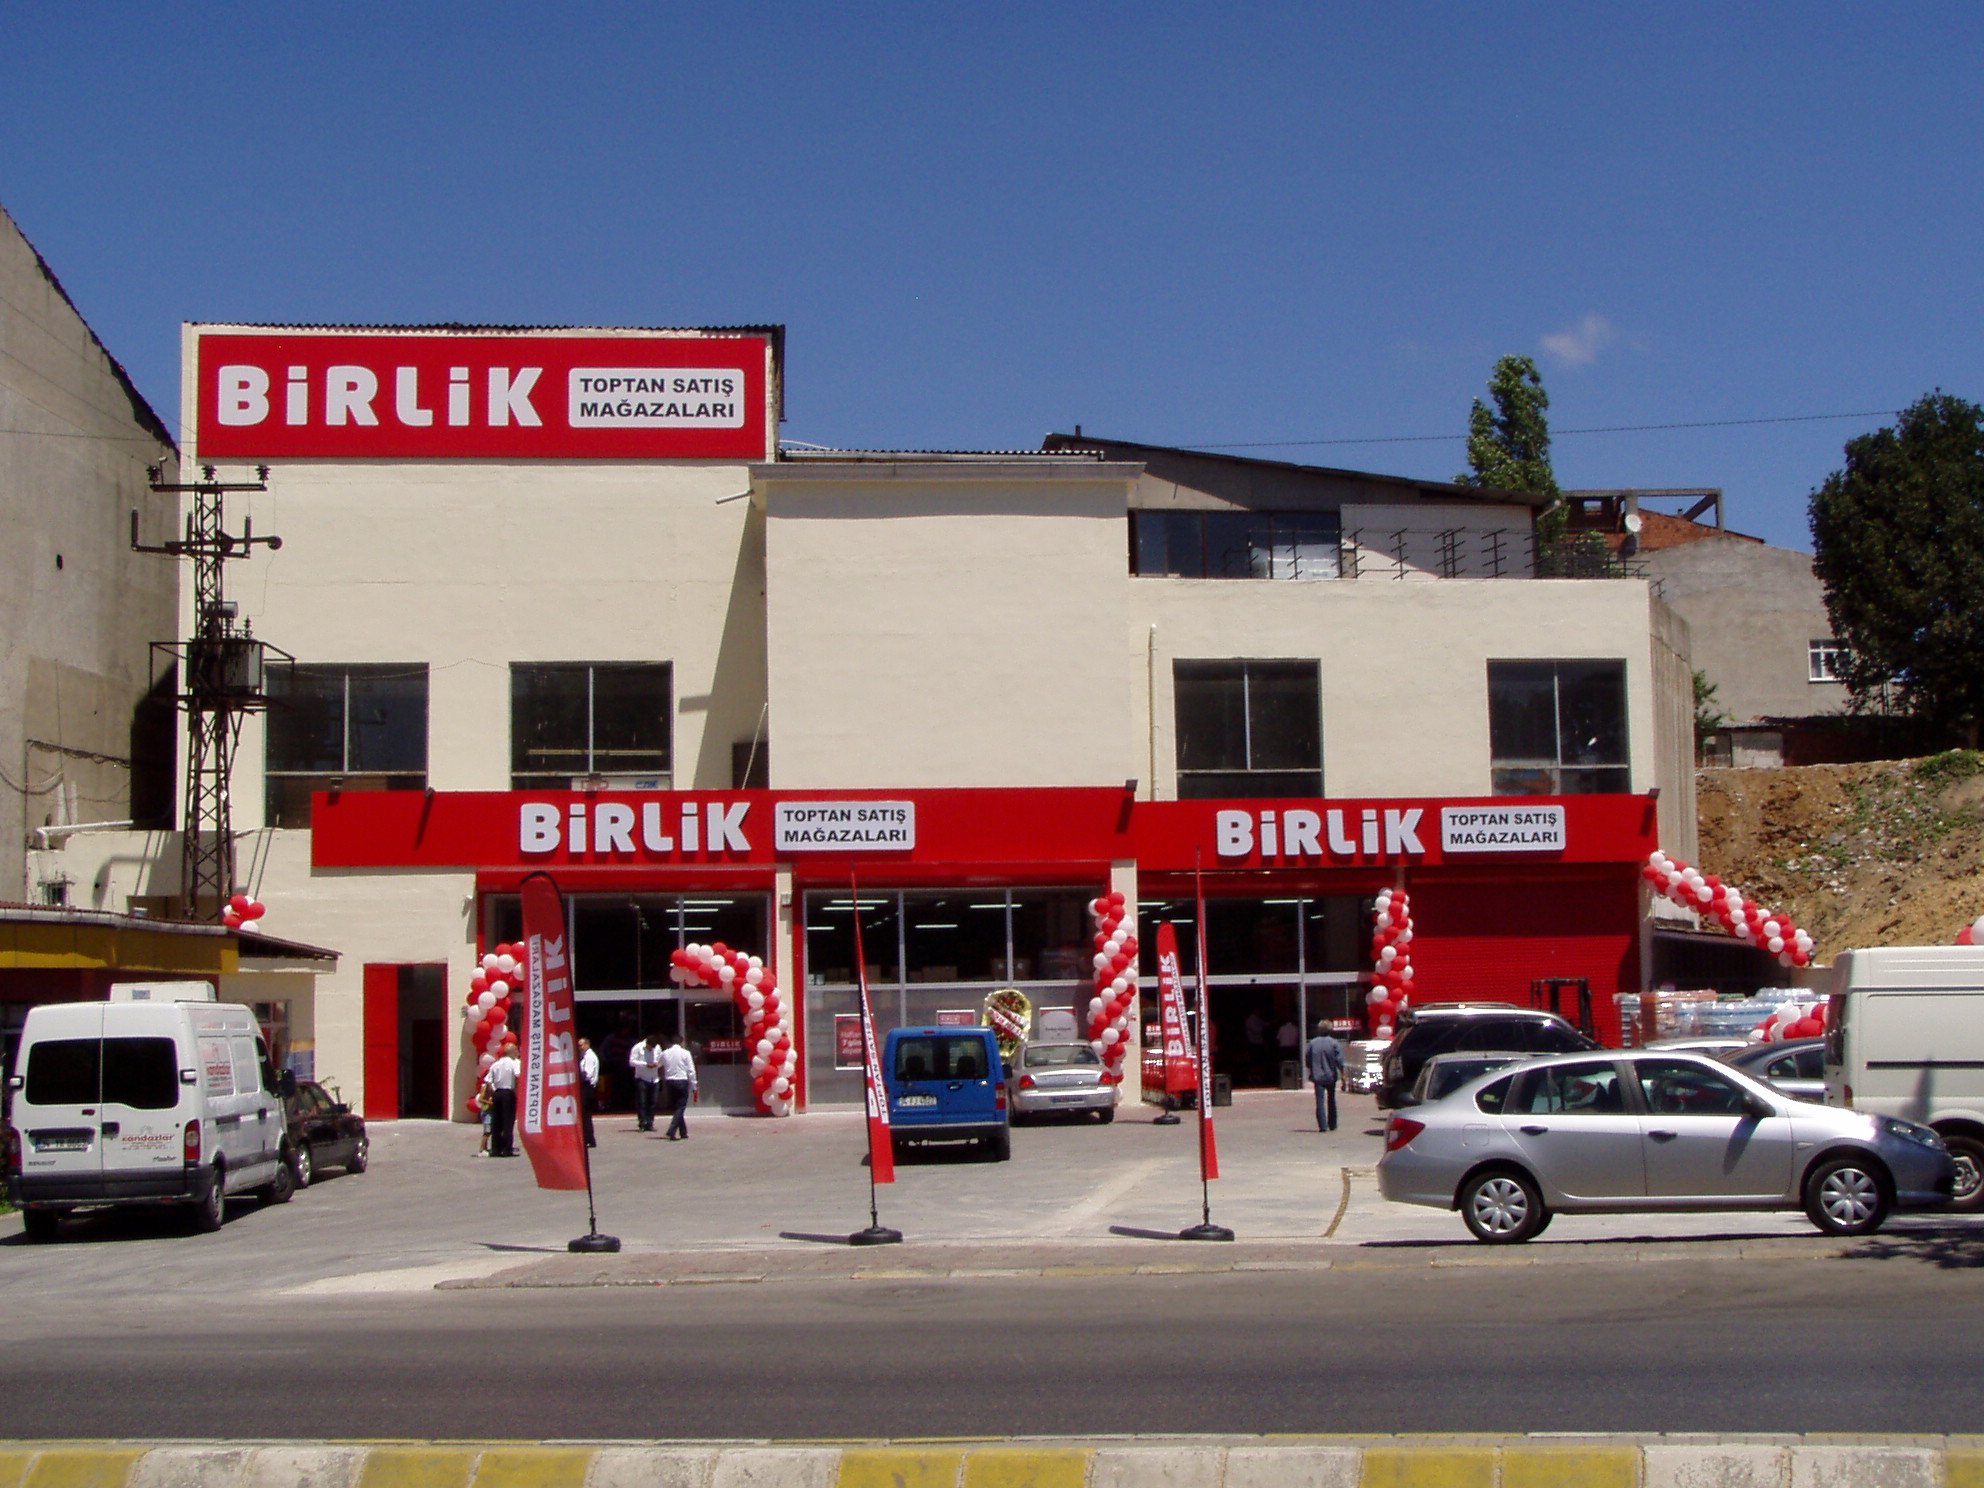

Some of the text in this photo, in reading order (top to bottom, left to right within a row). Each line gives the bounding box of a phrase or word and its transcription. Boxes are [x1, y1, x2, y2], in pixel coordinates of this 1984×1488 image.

[580, 377, 734, 398] TOPTAN SATIŞ
[580, 399, 734, 418] MAĞAZALARI
[784, 809, 906, 825] TOPTAN SATIŞ
[1449, 812, 1557, 827] TOPTAN SATIŞ
[784, 826, 907, 843] MAĞAZALARI
[1450, 829, 1558, 844] MAĞAZALARI
[873, 1063, 887, 1115] TOPTAN
